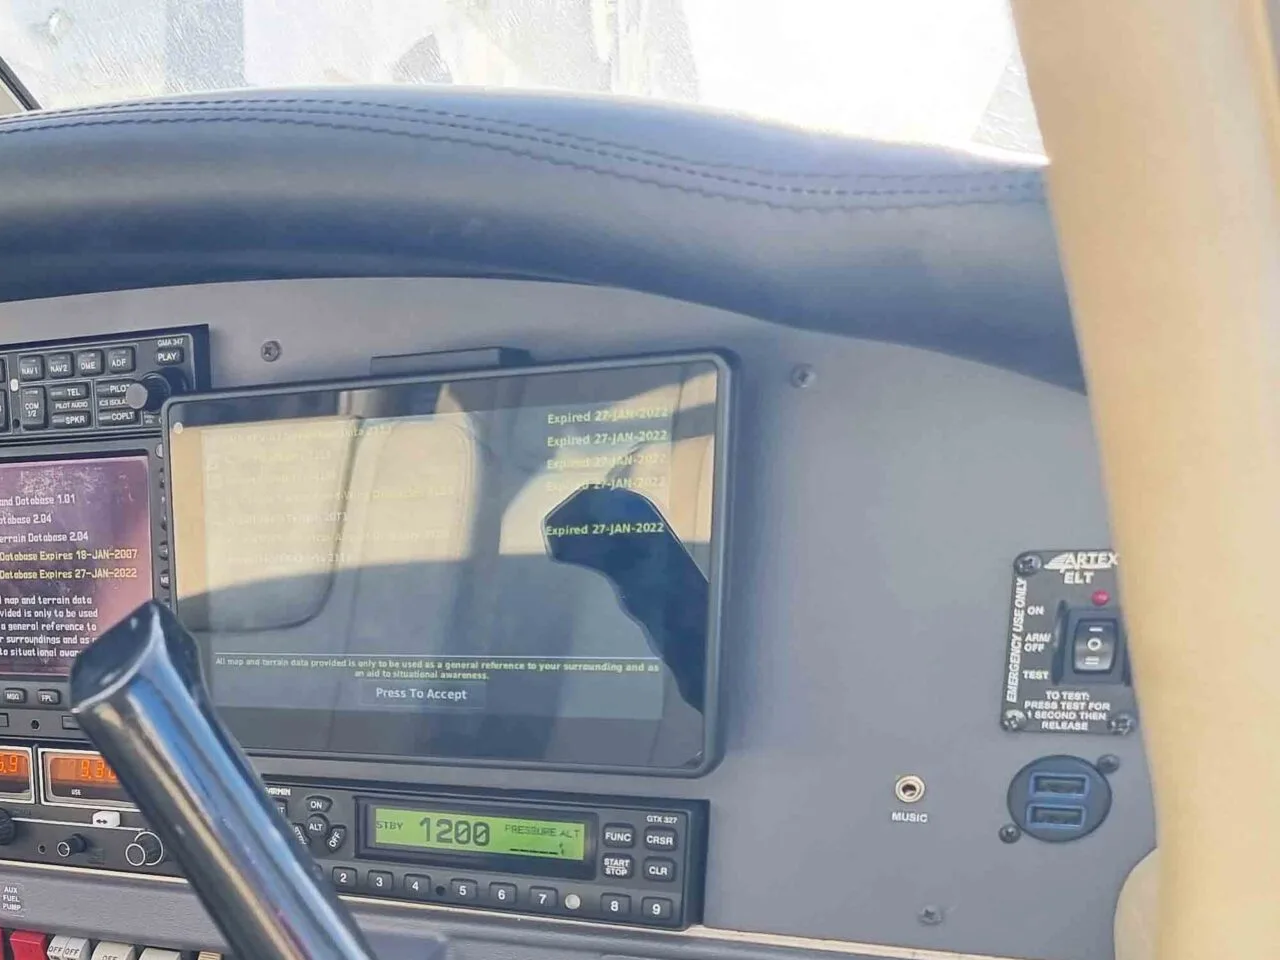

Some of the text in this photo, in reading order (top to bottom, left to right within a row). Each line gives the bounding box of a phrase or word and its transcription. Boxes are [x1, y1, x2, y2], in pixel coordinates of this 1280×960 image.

[112, 359, 126, 367] ADF
[65, 416, 85, 424] SPKR
[548, 410, 590, 425] Expired
[548, 430, 667, 448] Expired 27-JAN-2022
[15, 495, 54, 506] Database
[546, 523, 664, 538] Expired 27-JAN-2022
[0, 551, 37, 561] Database
[40, 550, 72, 561] Expires
[1066, 552, 1119, 566] ARTEX
[0, 569, 37, 579] Database
[40, 569, 72, 579] Expires
[75, 568, 138, 578] 27-JAN-2022
[1064, 572, 1094, 584] ELT
[1027, 606, 1044, 615] ON
[1006, 578, 1027, 703] EMERGENCY USE ONLY
[1025, 633, 1051, 642] ARM/
[1024, 643, 1044, 652] OFF
[1023, 671, 1049, 680] TEST
[6, 692, 20, 700] MSG
[41, 694, 53, 702] FPL
[376, 687, 468, 701] Press To Accept
[1046, 691, 1060, 700] TO
[1024, 701, 1110, 710] PRESS TEST FOR
[1035, 711, 1076, 720] SECOND
[1080, 712, 1106, 721] THEN
[1042, 721, 1088, 731] RELEASE
[310, 801, 322, 809] ON
[647, 815, 677, 824] GTX 327
[892, 812, 928, 823] MUSIC
[309, 823, 323, 831] ALT
[376, 817, 490, 847] STBY 1200
[505, 824, 580, 839] PRESSURE ALT
[329, 831, 340, 848] OFF
[605, 832, 631, 842] FUNC
[647, 835, 673, 846] CRSR
[604, 858, 630, 867] START
[605, 868, 627, 876] STOP
[649, 866, 668, 875] CLR
[340, 873, 347, 883] 2
[376, 877, 383, 887] 3
[3, 895, 20, 903] FUEL
[610, 901, 619, 911] 8
[652, 904, 661, 915] 9
